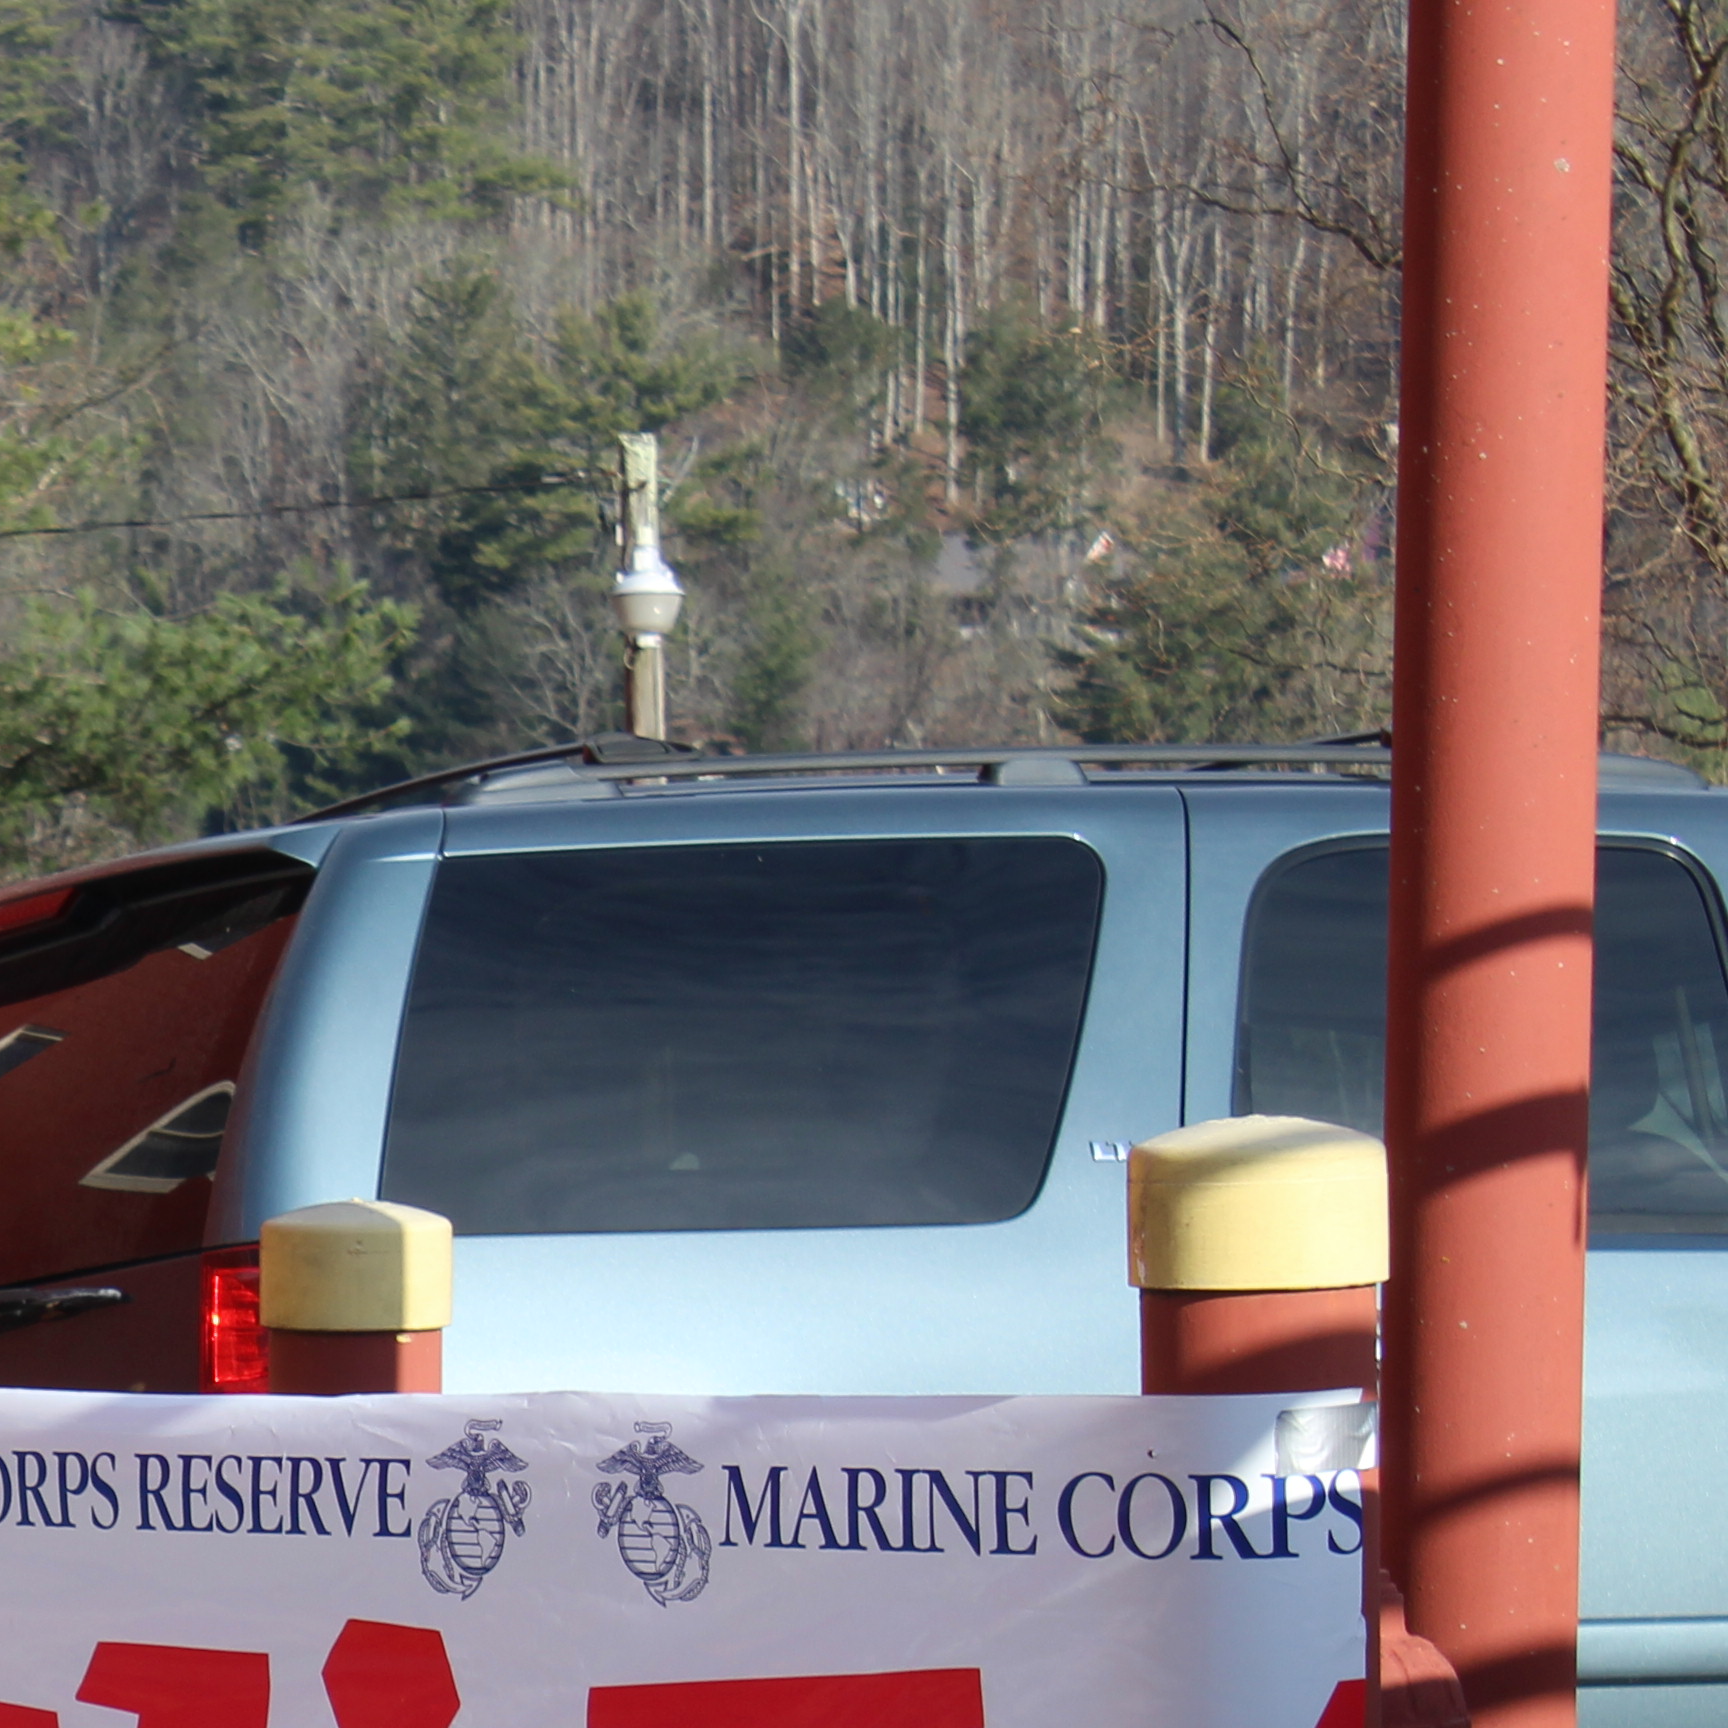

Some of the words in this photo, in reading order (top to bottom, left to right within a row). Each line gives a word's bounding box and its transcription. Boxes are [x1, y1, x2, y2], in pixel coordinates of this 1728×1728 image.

[134, 1452, 412, 1540] RESERVE
[720, 1464, 1038, 1556] MARINE
[1057, 1468, 1362, 1561] CORPS
